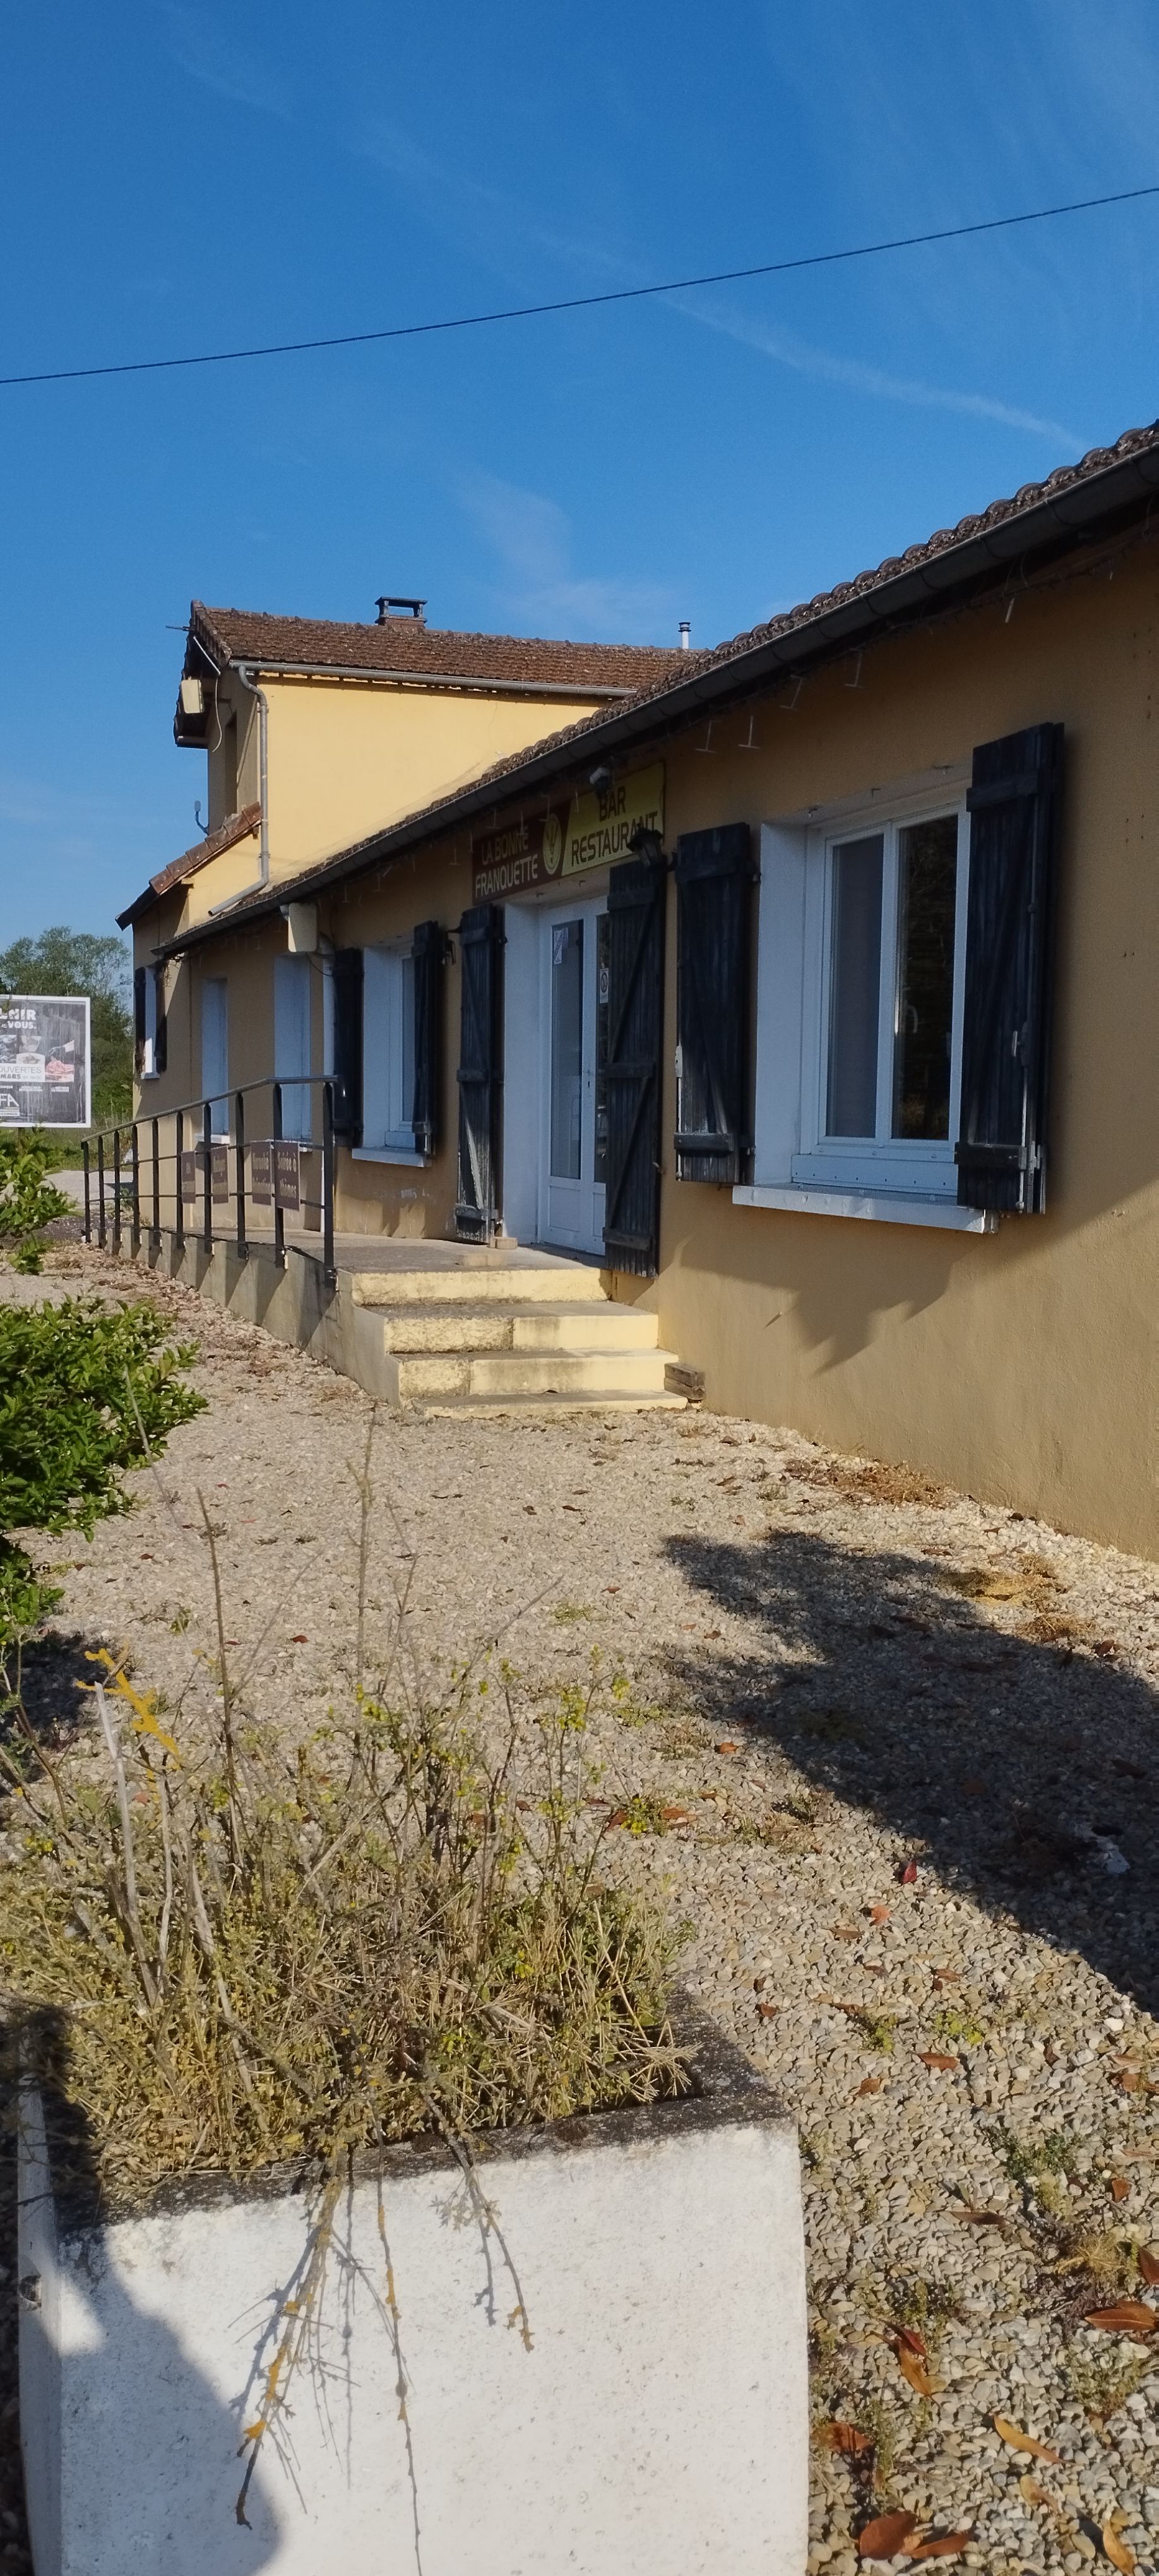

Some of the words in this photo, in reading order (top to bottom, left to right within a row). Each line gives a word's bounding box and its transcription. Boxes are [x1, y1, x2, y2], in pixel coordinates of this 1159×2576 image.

[599, 787, 626, 821] BAR
[482, 842, 493, 865] LA
[495, 825, 528, 860] BONNE
[475, 853, 538, 898] FRANQUETTE
